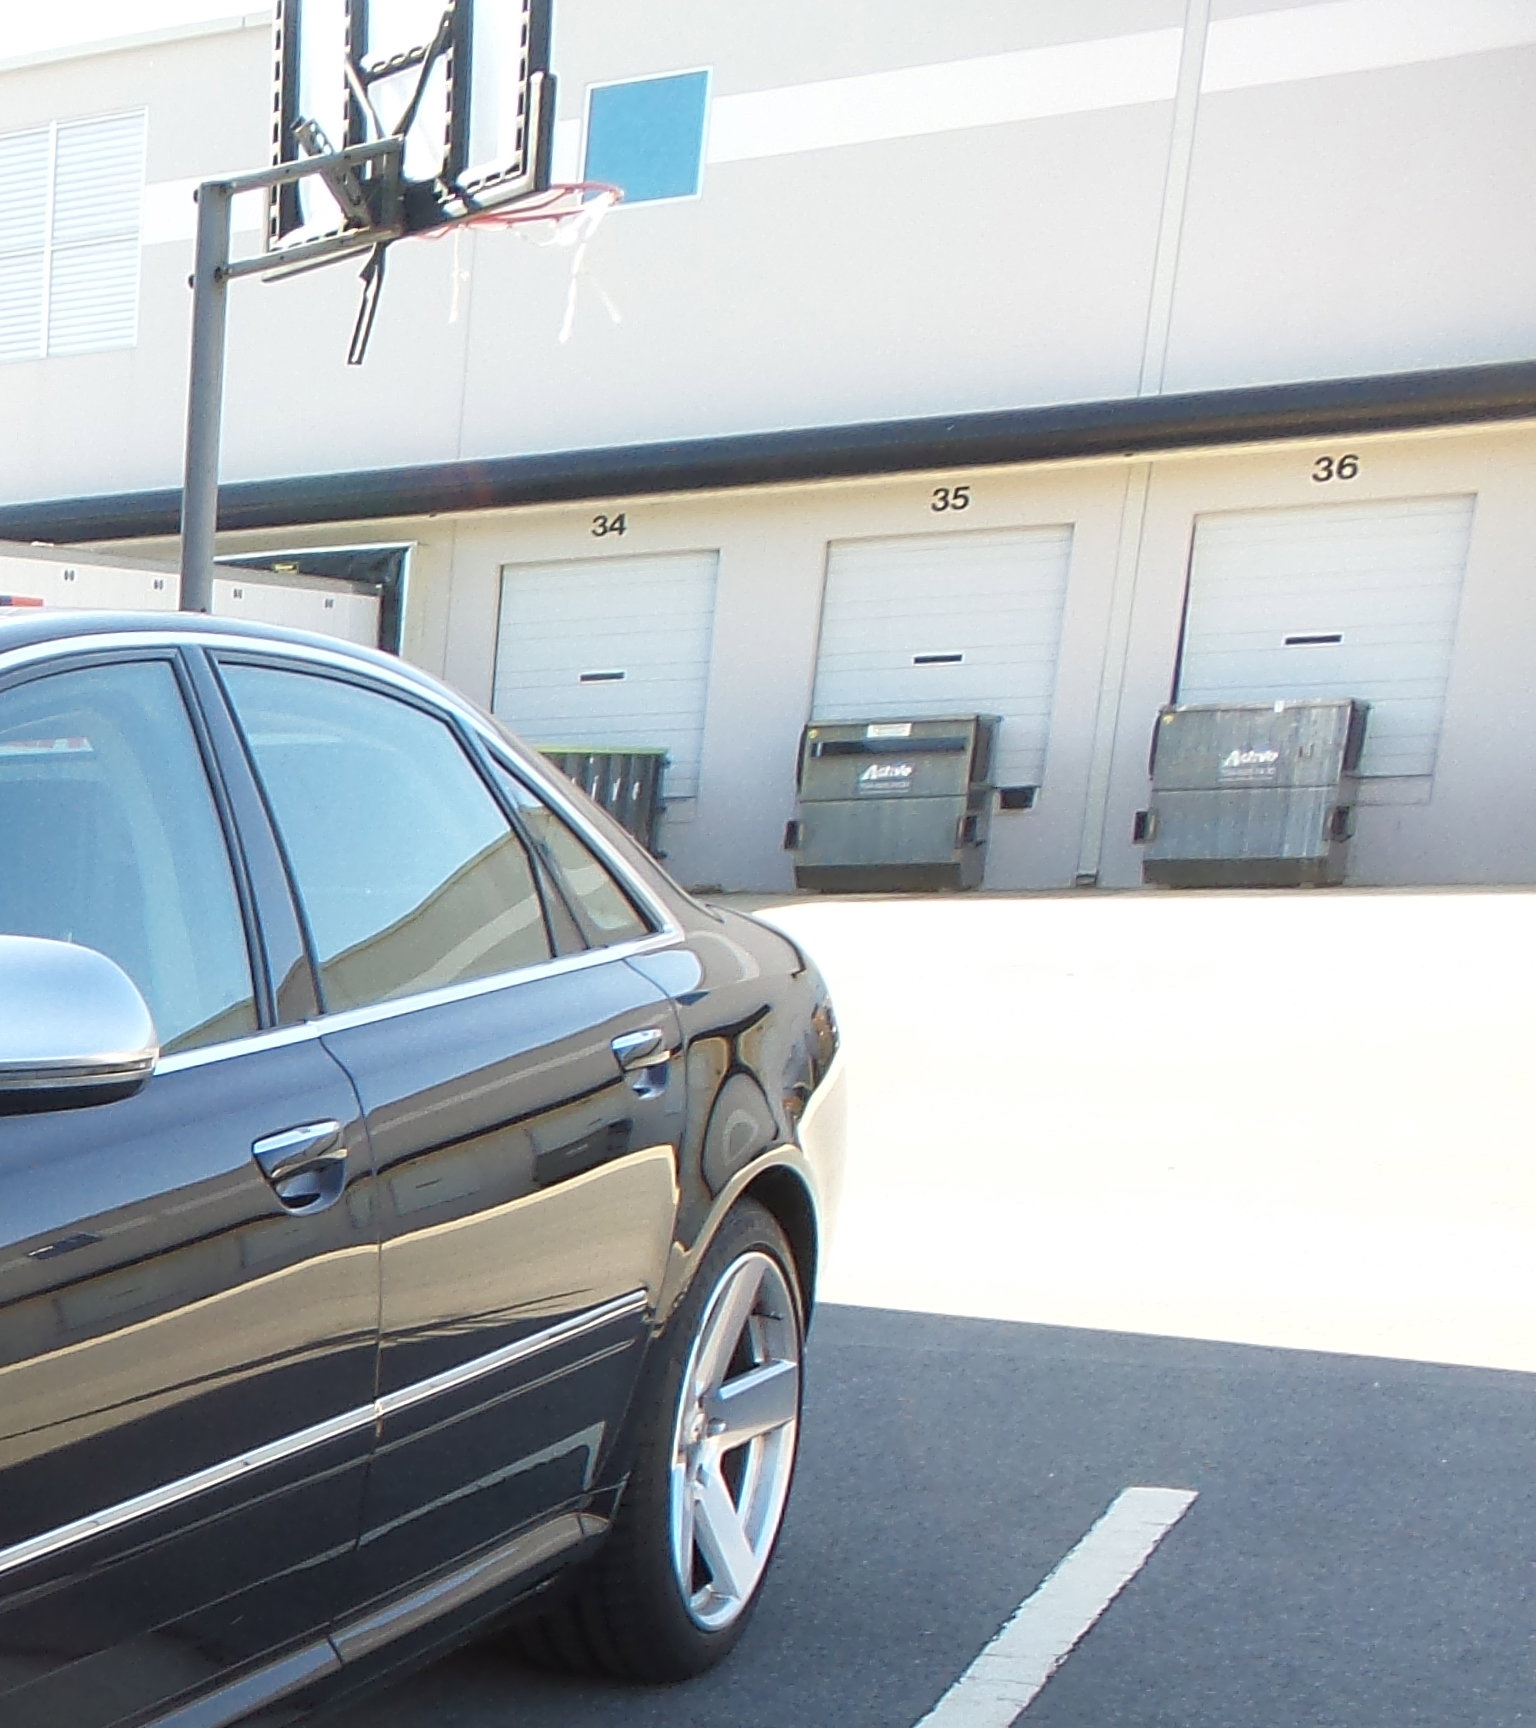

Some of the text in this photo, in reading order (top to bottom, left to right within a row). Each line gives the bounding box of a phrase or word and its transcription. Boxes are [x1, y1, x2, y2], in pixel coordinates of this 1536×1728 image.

[1312, 453, 1359, 482] 36
[931, 485, 970, 512] 35
[591, 513, 627, 537] 34
